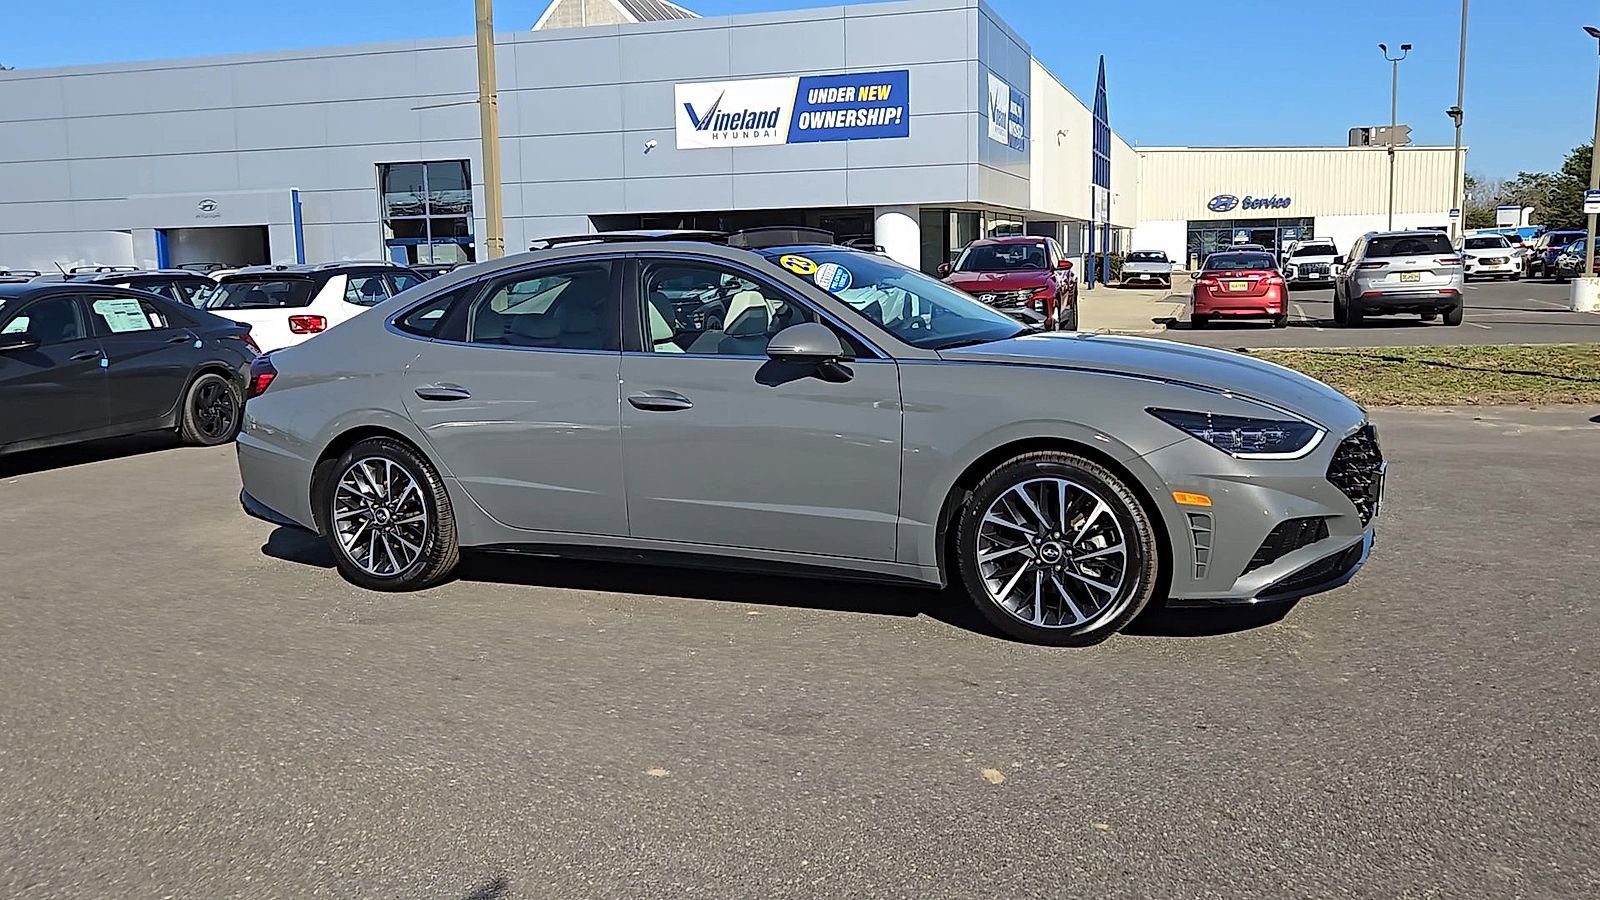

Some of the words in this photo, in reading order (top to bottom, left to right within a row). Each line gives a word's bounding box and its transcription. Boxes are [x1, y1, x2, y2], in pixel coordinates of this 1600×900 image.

[808, 86, 856, 104] UNDER
[858, 85, 892, 102] NEW
[683, 89, 781, 131] Vineland
[798, 106, 903, 130] OWNERSHIP!
[712, 130, 777, 140] HYUNDAI
[1242, 194, 1292, 210] Service
